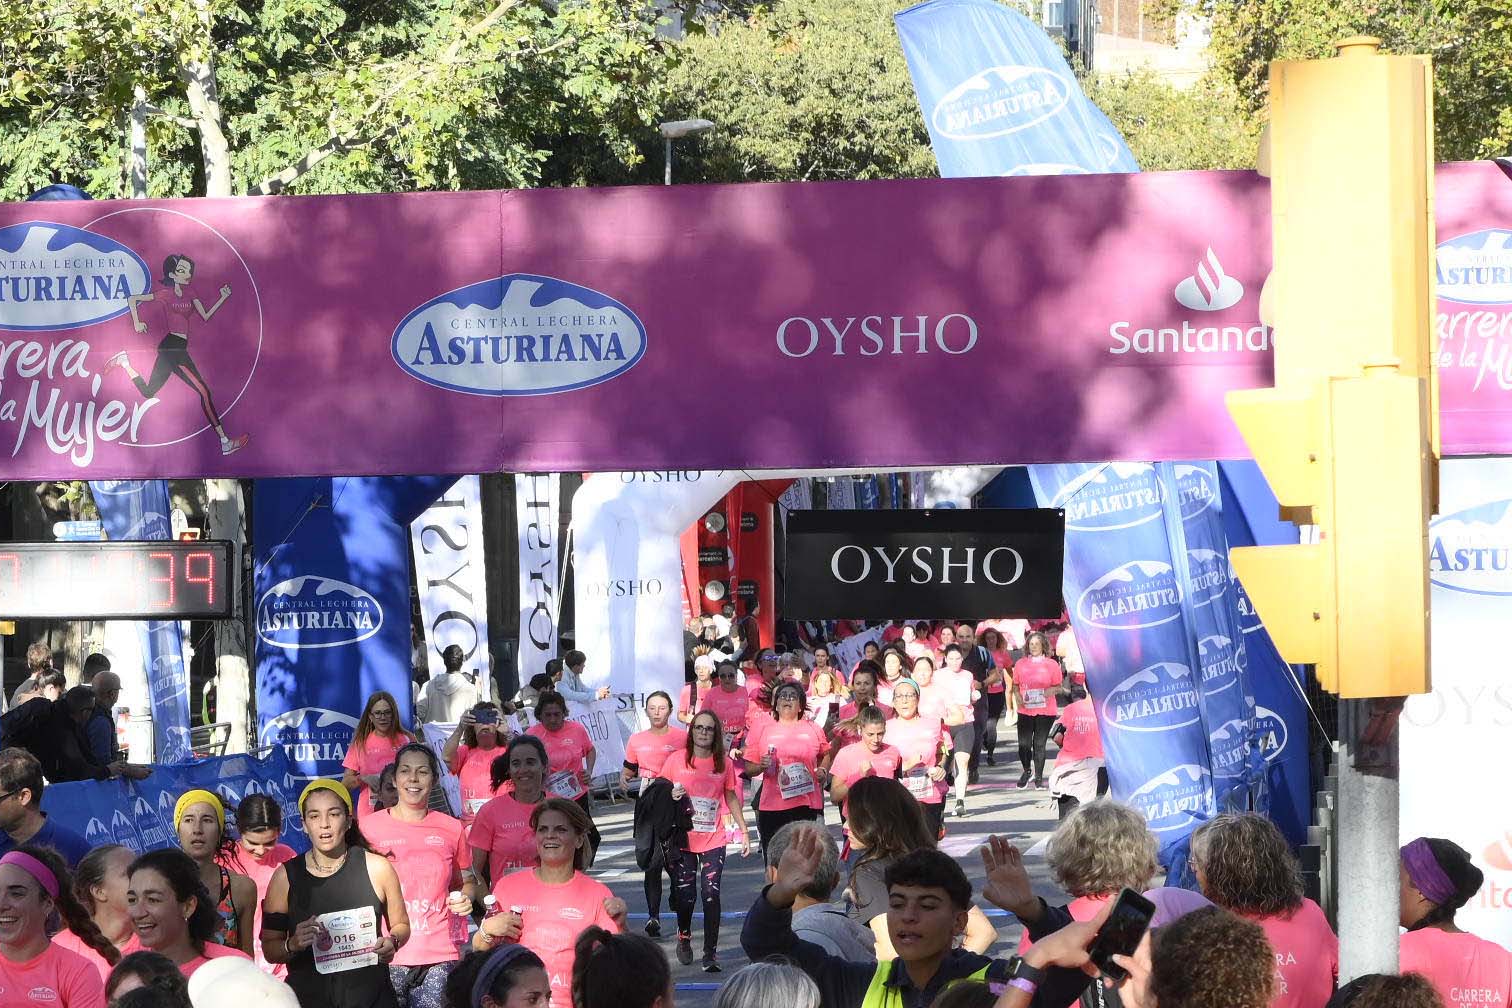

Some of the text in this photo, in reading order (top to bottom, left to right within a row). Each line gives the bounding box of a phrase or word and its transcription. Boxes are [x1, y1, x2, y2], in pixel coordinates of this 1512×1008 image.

[54, 256, 126, 269] LECHERA
[450, 314, 618, 330] CENTRAL LECHERA
[411, 321, 627, 367] ASTURIANA
[775, 313, 979, 358] OYSHO
[1109, 320, 1275, 355] Santand
[13, 372, 162, 468] Mujer
[830, 544, 1025, 586] OYSHO
[586, 578, 662, 598] OYSHO
[273, 600, 369, 610] CENTRAL LECHERA
[260, 604, 374, 633] ASTURIANA
[275, 731, 353, 741] CENTRAL LECH
[333, 933, 357, 945] 016
[1449, 986, 1503, 1003] CARRERA
